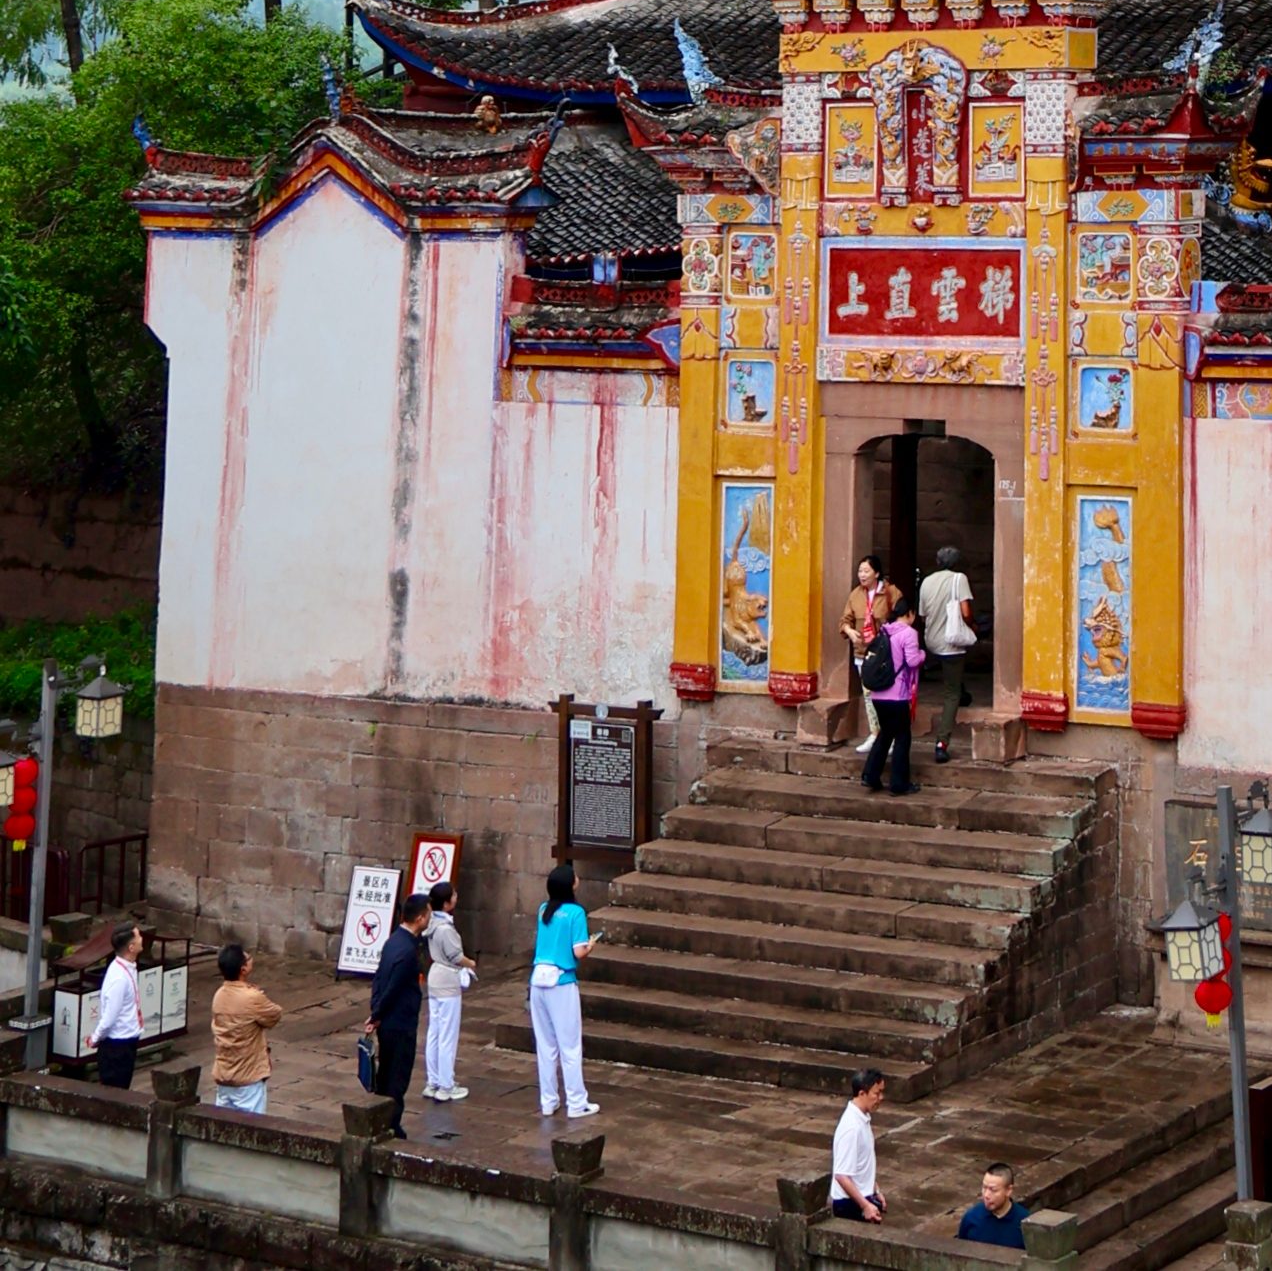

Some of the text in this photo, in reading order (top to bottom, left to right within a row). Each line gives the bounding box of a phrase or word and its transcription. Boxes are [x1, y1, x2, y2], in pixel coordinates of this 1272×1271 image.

[363, 875, 389, 889] 景区内
[355, 889, 392, 903] 未经批准
